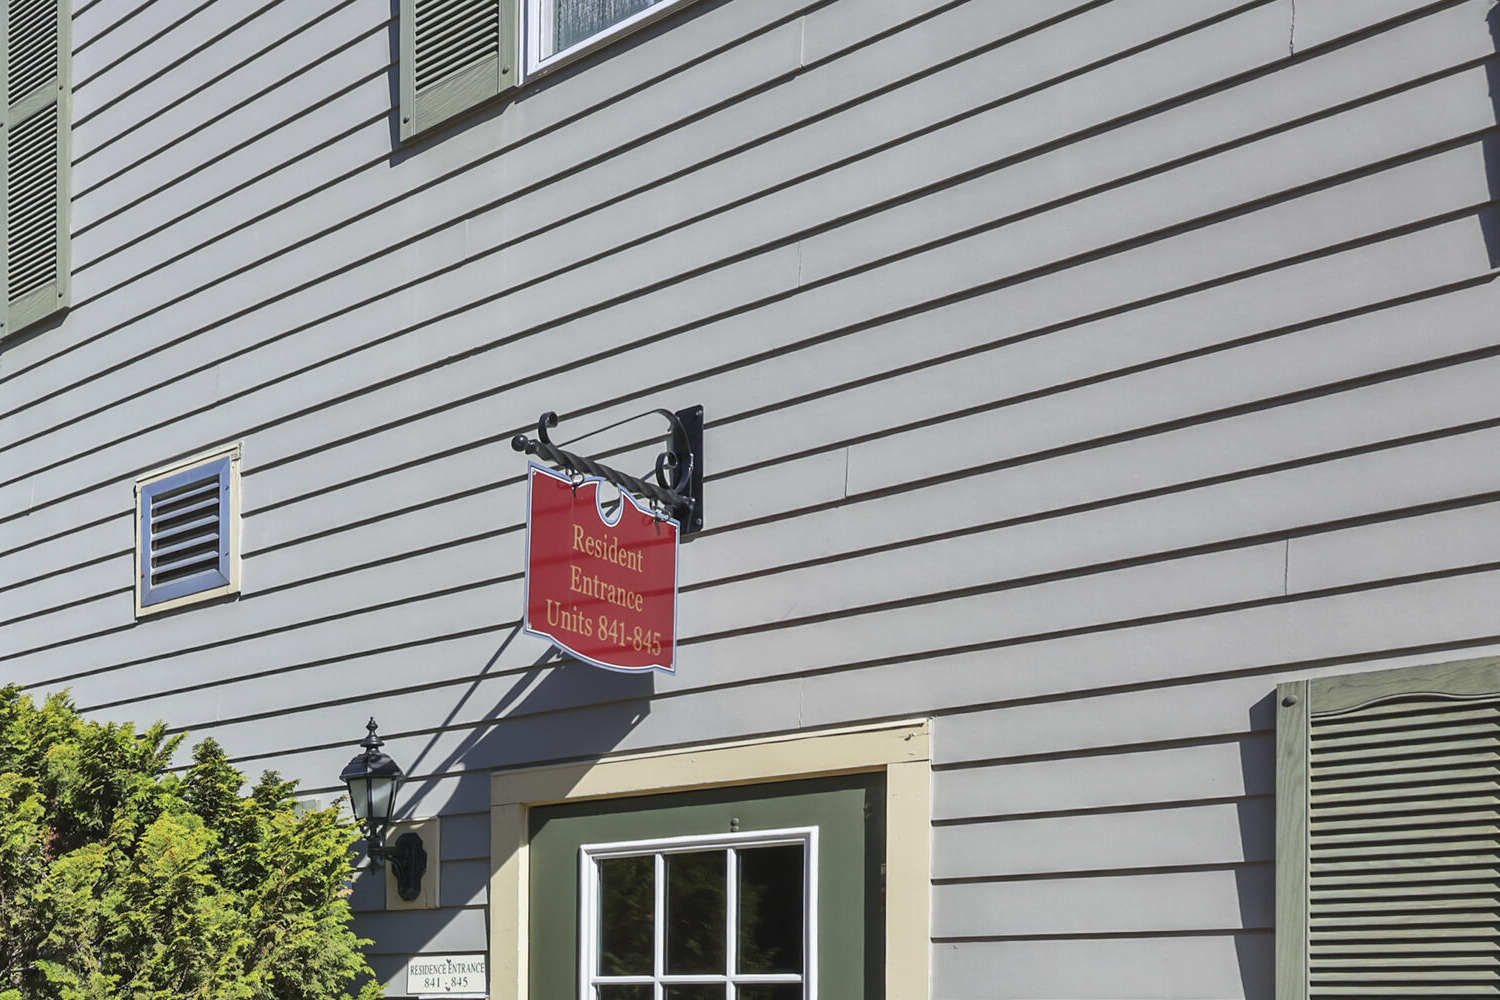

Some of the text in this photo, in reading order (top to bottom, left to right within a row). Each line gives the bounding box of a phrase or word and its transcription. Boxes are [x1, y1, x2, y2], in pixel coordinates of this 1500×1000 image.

[573, 523, 643, 573] Resident
[571, 565, 643, 612] Entrance
[546, 599, 662, 656] Units 841-845
[410, 962, 484, 975] RESIDENCE ENTRANCE
[424, 978, 440, 988] 841
[451, 977, 468, 987] 845
